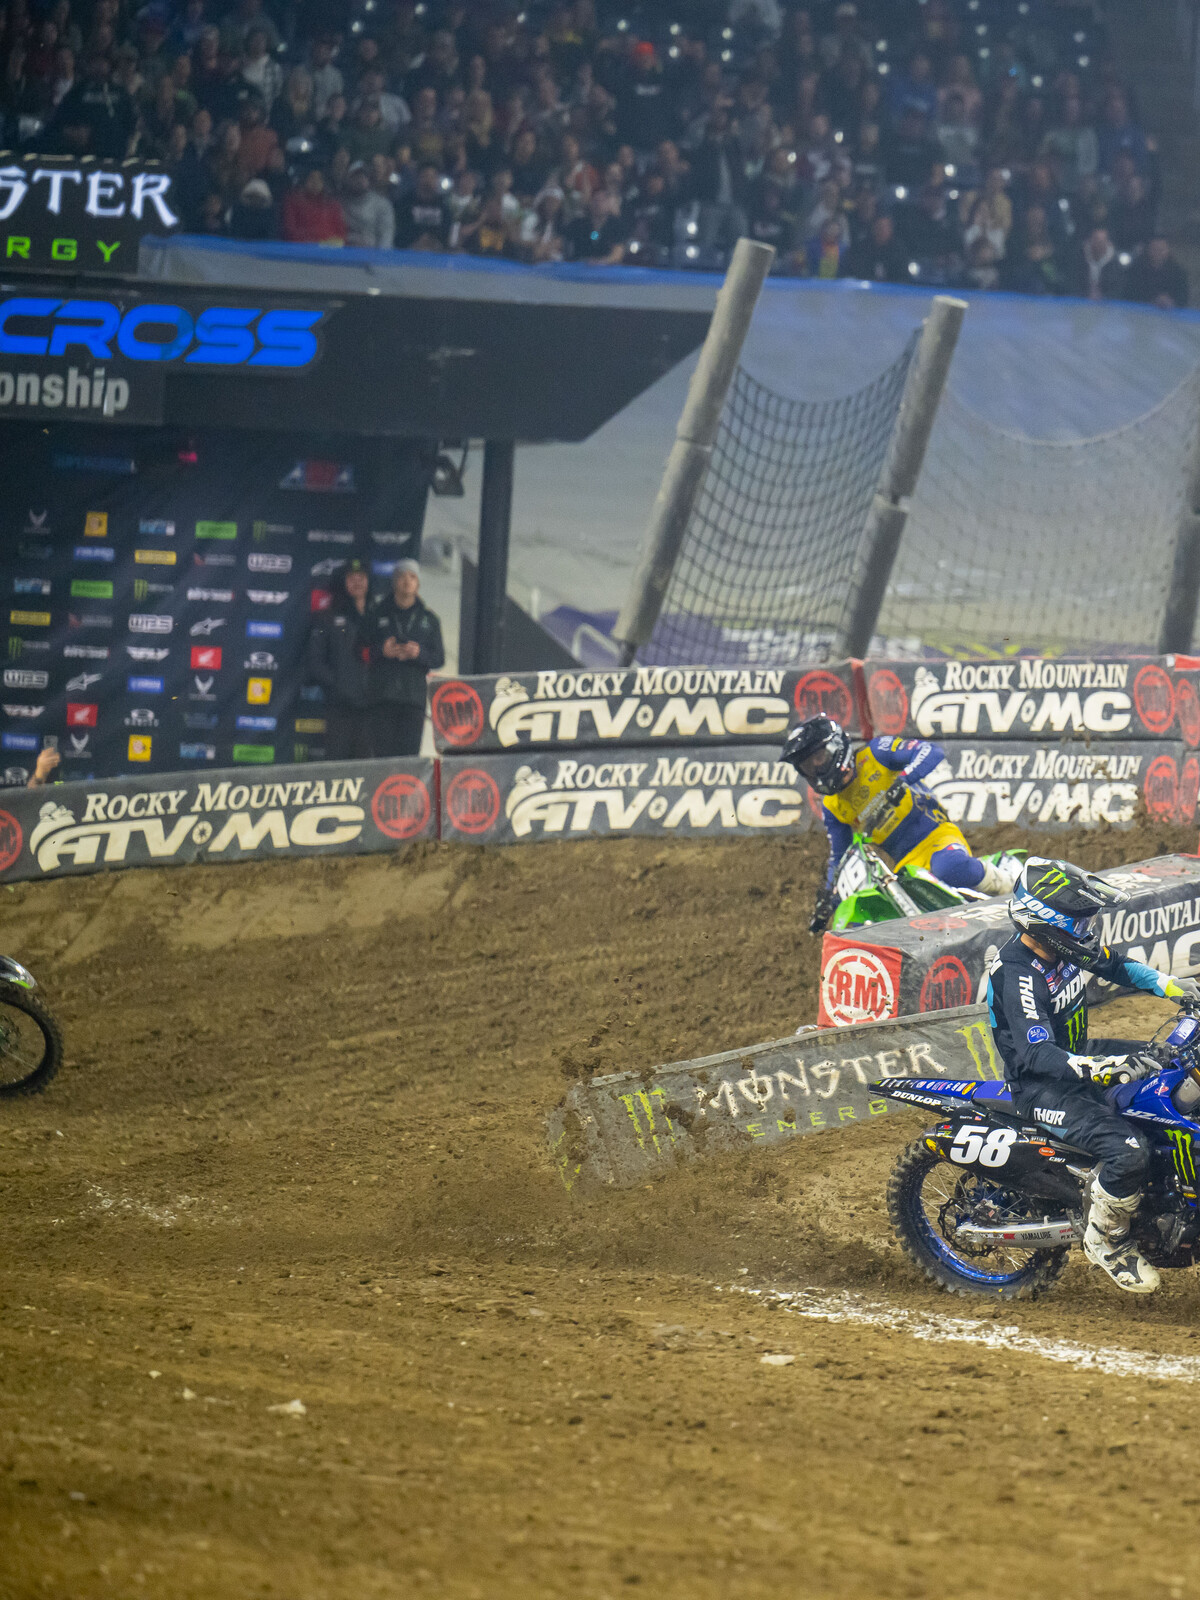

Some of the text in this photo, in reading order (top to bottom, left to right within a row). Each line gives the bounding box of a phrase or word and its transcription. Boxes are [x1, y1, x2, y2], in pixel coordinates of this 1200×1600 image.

[534, 668, 786, 699] ROCKY MOUNTAIN
[943, 660, 1129, 691] ROCKY MOUNTAIN
[552, 758, 799, 789] ROCKY MOUNTAIN
[956, 750, 1028, 779] ROCKY
[1032, 750, 1142, 780] MOUNTAIN
[82, 777, 364, 823] ROCKY MOUNTAIN
[835, 971, 878, 1011] RM
[696, 1042, 947, 1117] MONSTER
[891, 1090, 942, 1106] DUNLOP
[746, 1100, 889, 1138] ENERG
[1033, 1107, 1066, 1126] THOR
[950, 1124, 1017, 1168] 58
